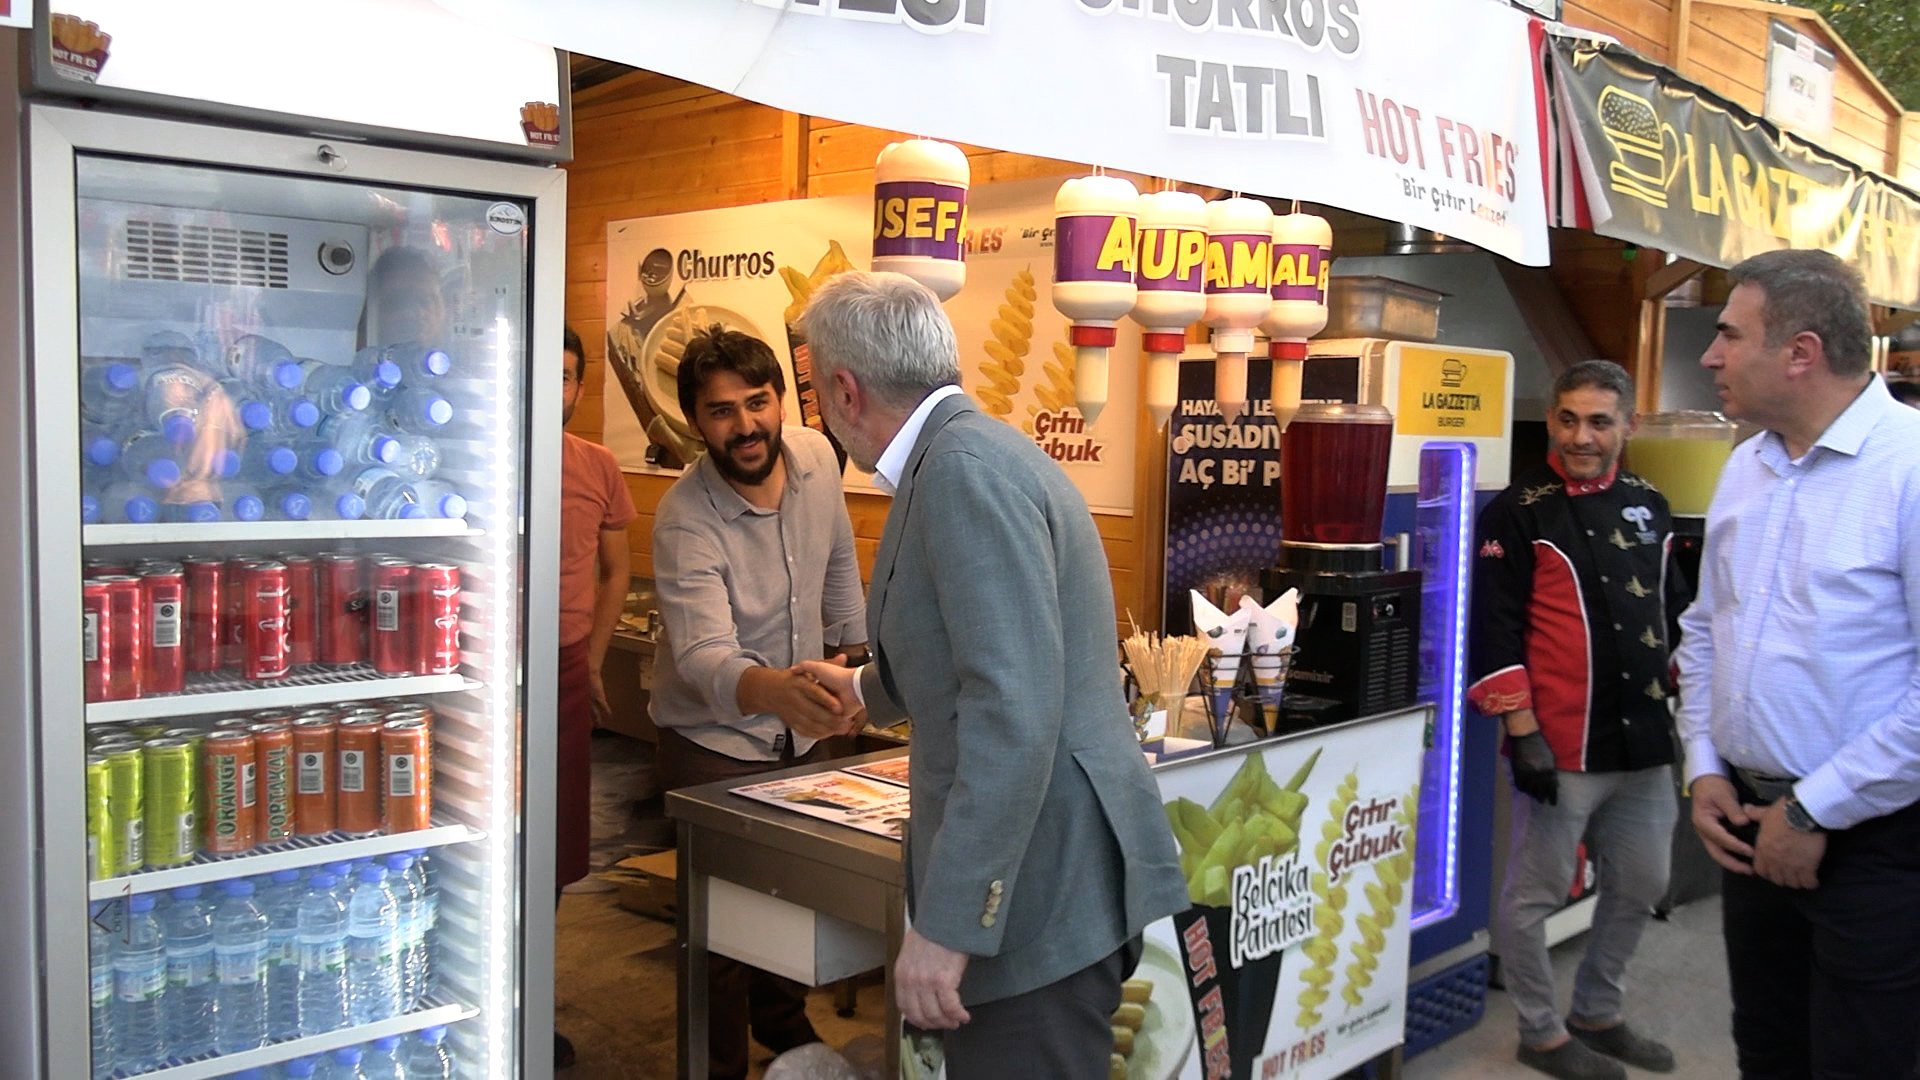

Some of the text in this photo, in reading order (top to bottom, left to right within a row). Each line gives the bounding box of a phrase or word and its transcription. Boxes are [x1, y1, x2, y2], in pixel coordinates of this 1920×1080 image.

[1156, 54, 1324, 138] TATLI
[1355, 88, 1516, 203] HOT FRIES
[677, 249, 775, 281] Churros
[1422, 393, 1481, 411] LA GAZZETTA
[1438, 417, 1465, 428] BURGER
[1179, 459, 1216, 490] AÇ
[216, 754, 237, 836] ORANGE
[267, 746, 288, 838] PORTAKAL
[1345, 799, 1396, 842] Çıtır
[1236, 852, 1309, 909] Belçika
[1329, 826, 1402, 882] Çubuk
[1183, 916, 1231, 1080] HOT FRIES
